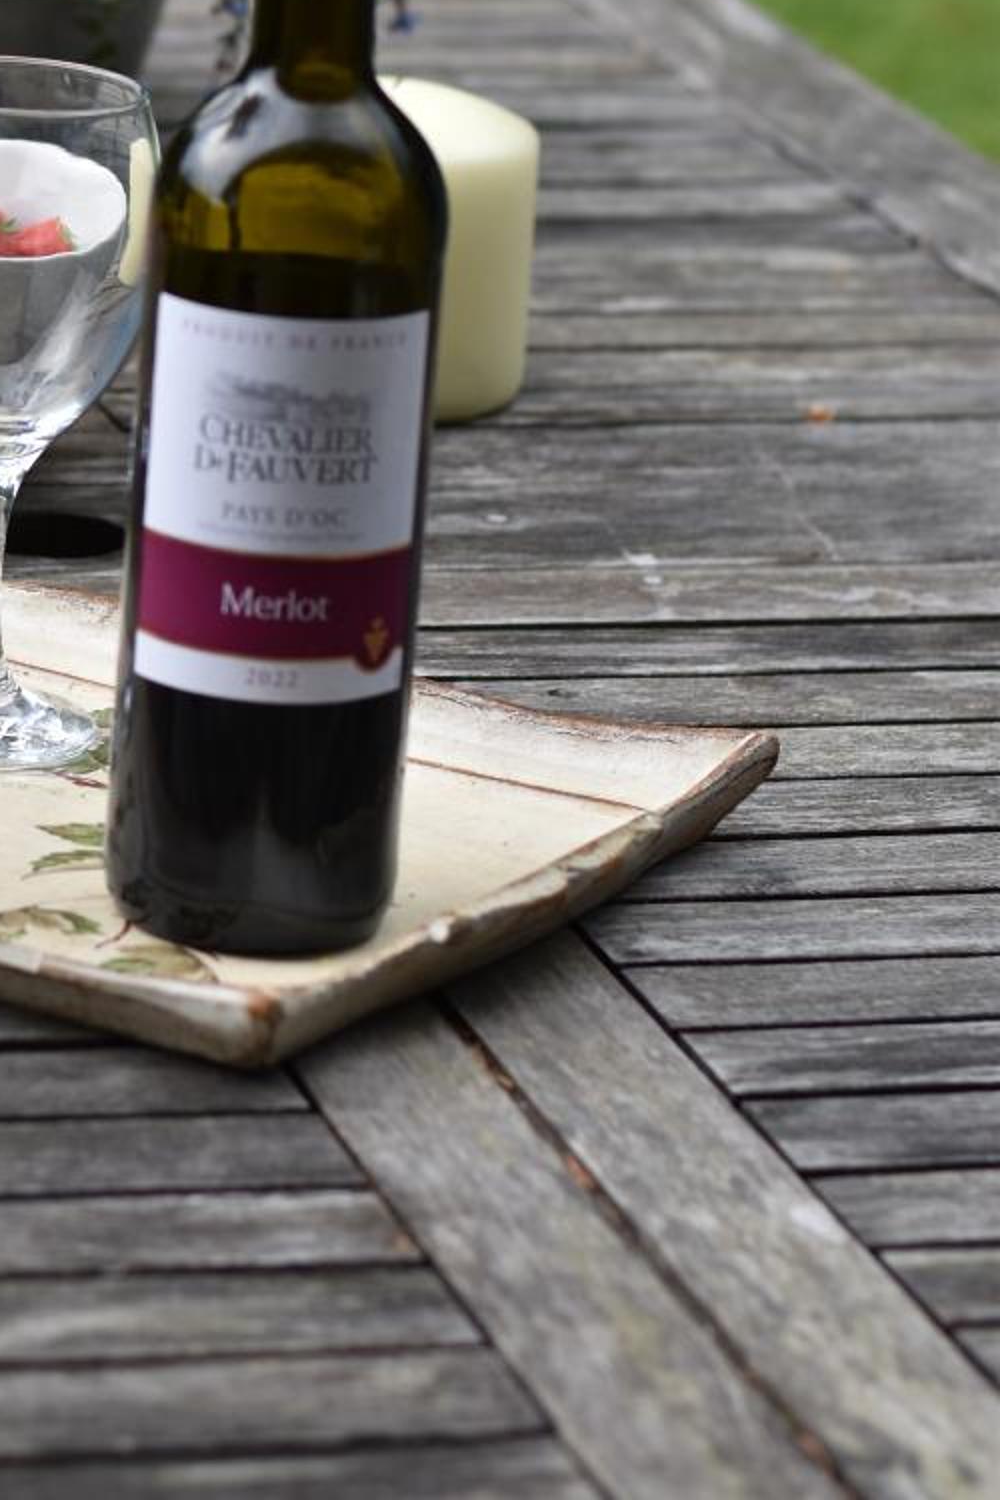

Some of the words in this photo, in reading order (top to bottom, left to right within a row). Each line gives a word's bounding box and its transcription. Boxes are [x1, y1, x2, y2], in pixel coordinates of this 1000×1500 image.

[199, 412, 375, 454] CHEVALIER
[227, 451, 378, 485] FAUVERT
[221, 501, 275, 525] PAYS
[220, 580, 329, 622] Merlot
[245, 667, 298, 688] 2022
